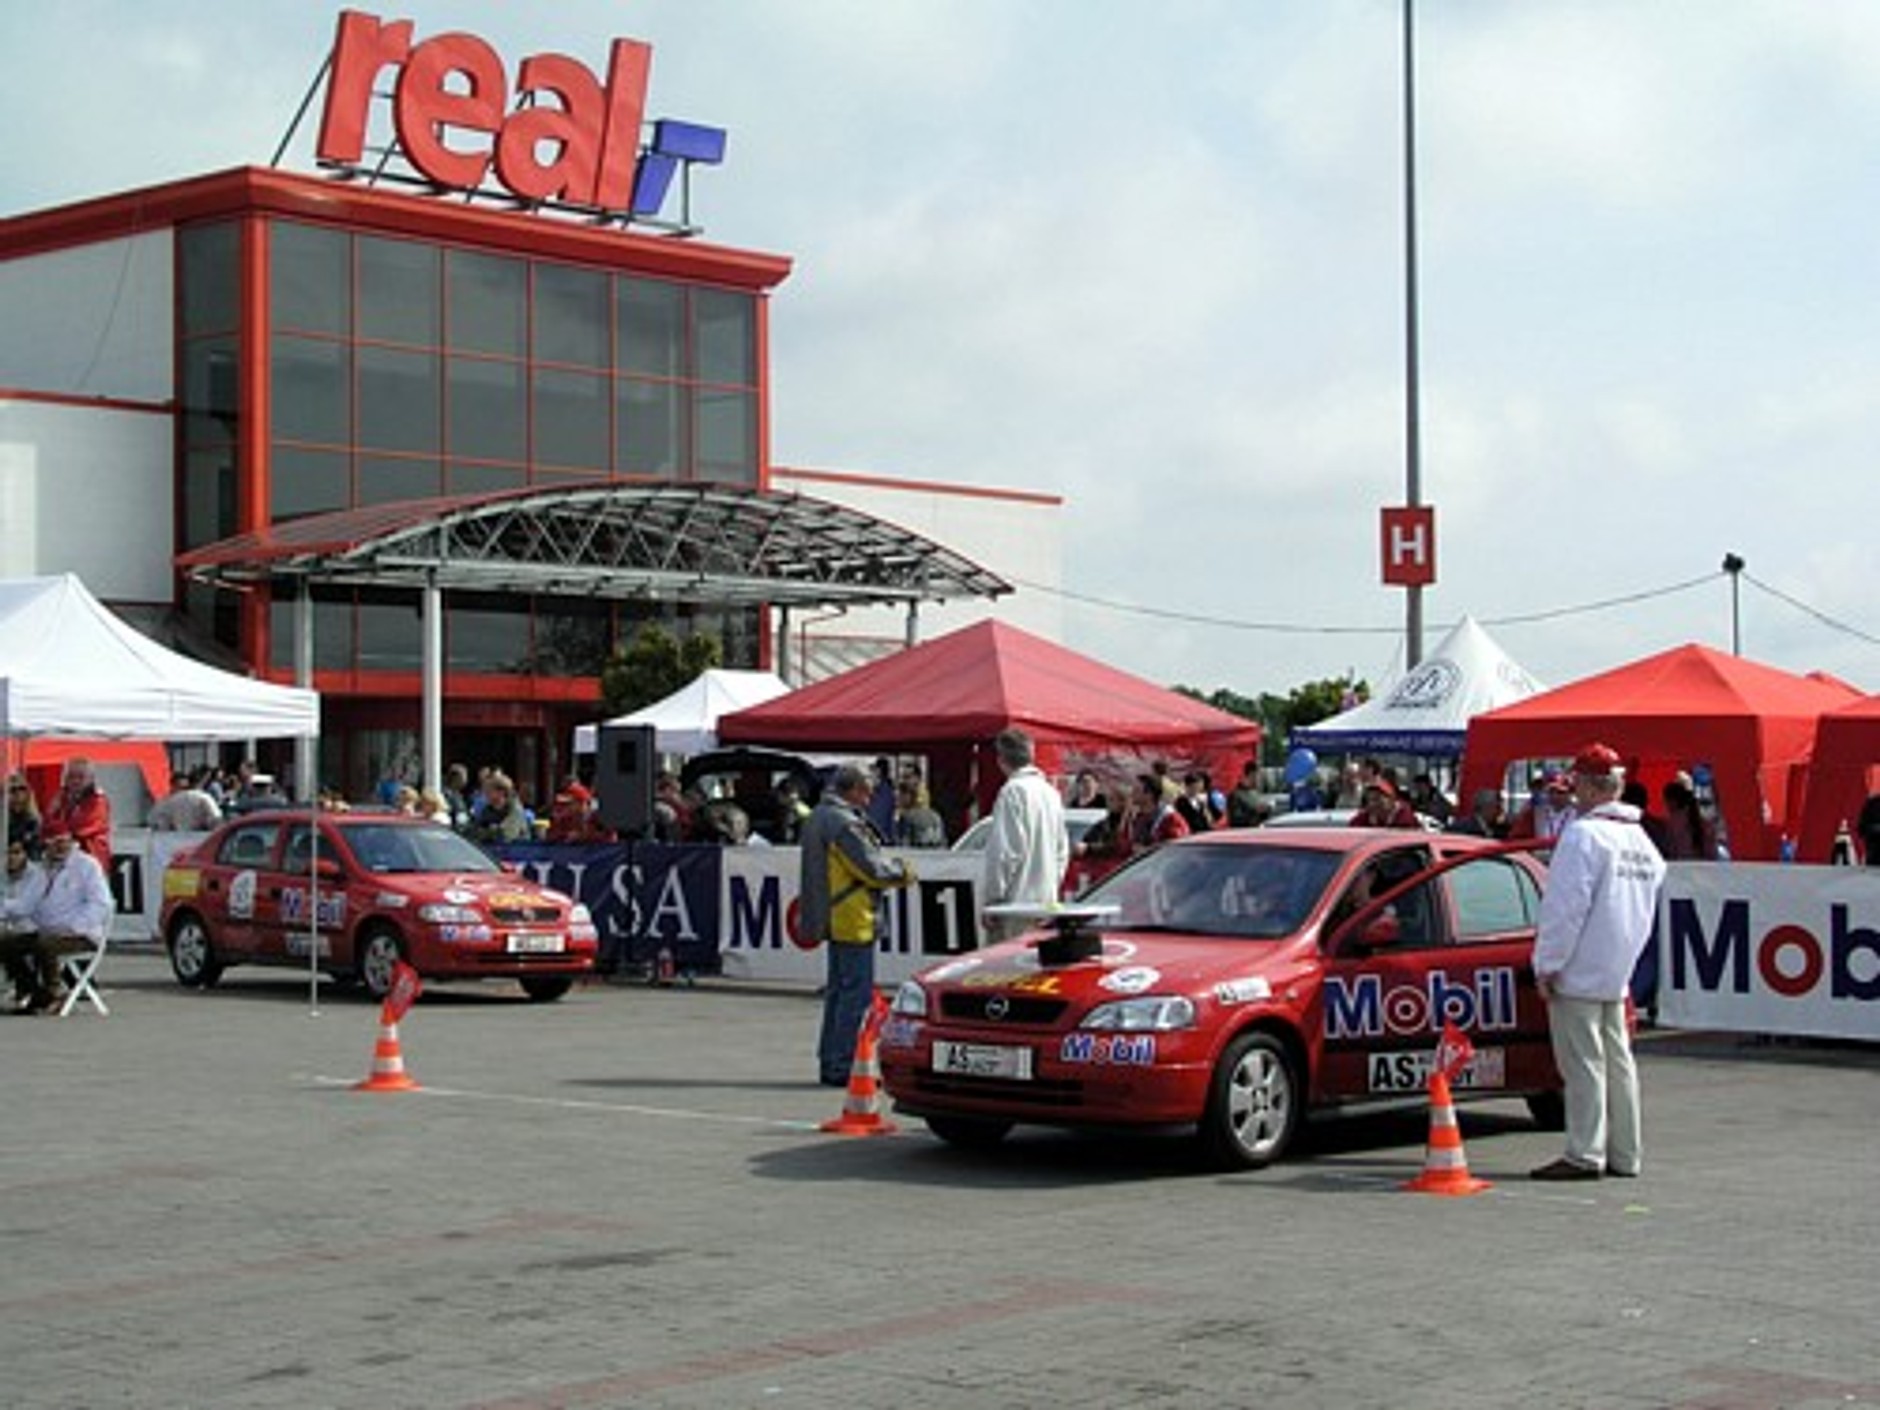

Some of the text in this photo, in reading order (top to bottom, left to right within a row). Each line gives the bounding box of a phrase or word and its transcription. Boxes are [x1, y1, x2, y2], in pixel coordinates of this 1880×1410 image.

[1391, 525, 1426, 565] H
[119, 858, 133, 911] 1
[936, 887, 960, 950] 1
[1325, 967, 1516, 1038] Mobil
[1061, 1034, 1156, 1065] Mobil
[1372, 1056, 1415, 1089] AS
